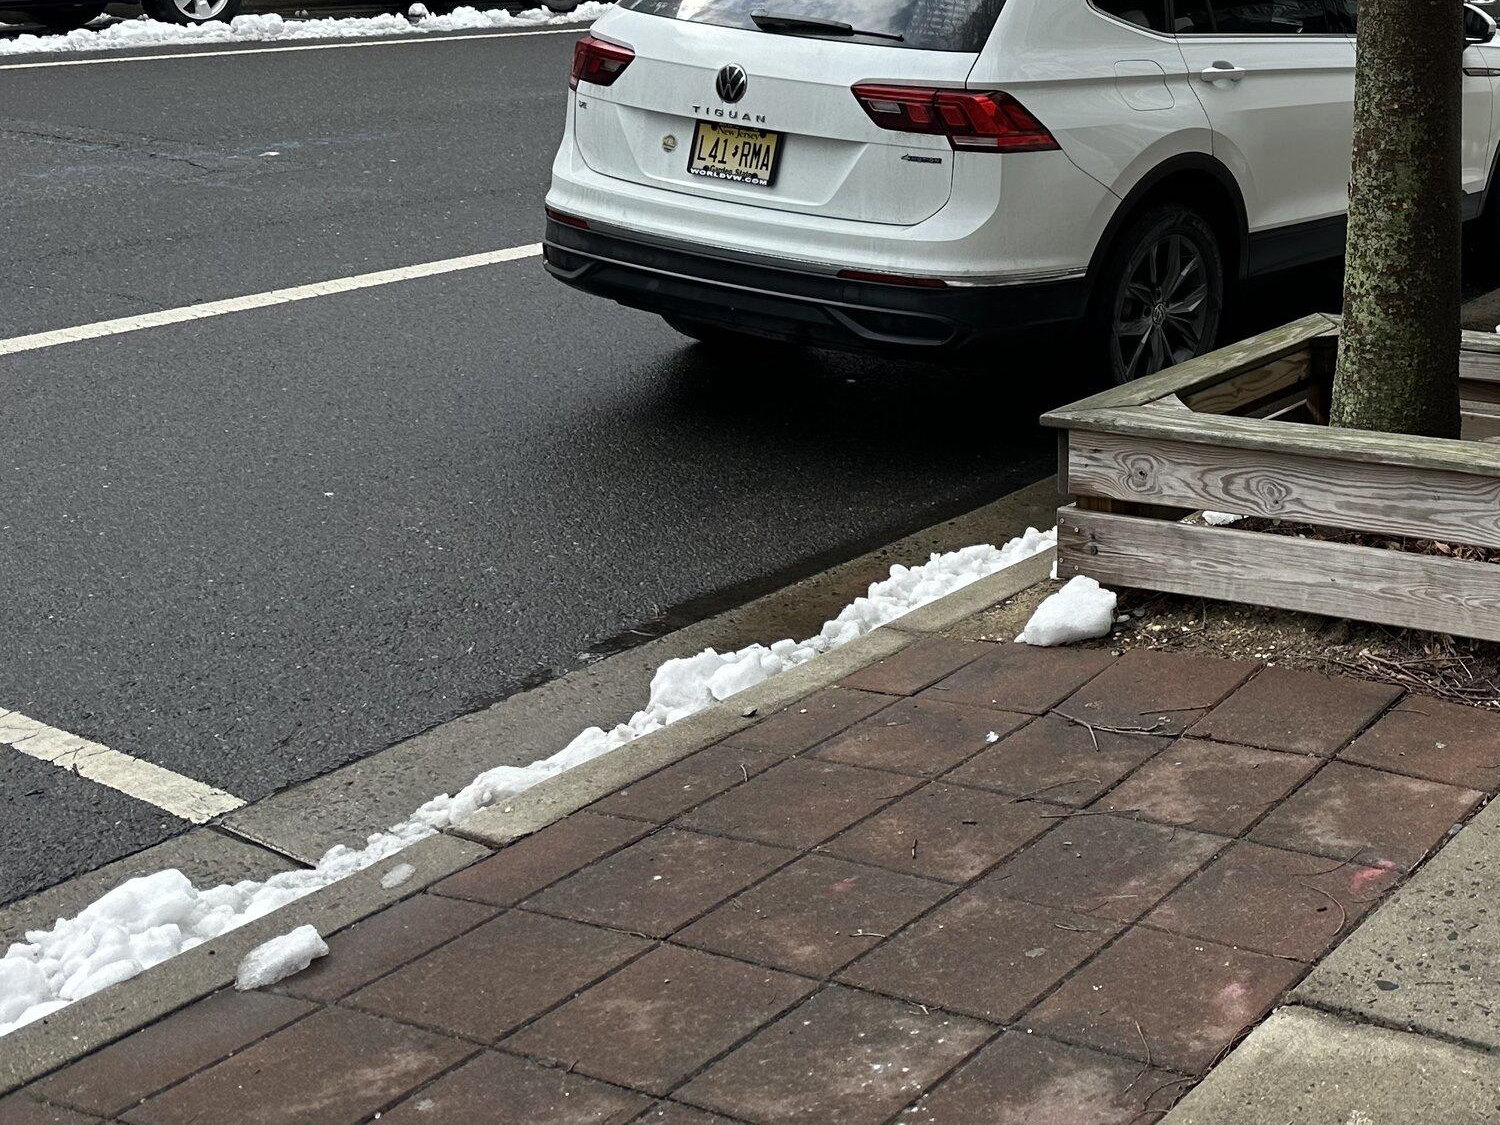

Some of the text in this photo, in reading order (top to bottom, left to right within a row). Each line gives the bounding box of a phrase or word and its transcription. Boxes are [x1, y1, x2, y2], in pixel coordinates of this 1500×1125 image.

[692, 105, 767, 124] TIGUAN
[717, 126, 734, 136] New
[735, 128, 761, 141] Jersey
[696, 134, 729, 165] L41
[738, 140, 772, 172] RMA
[689, 167, 768, 186] WORLDVW.COM
